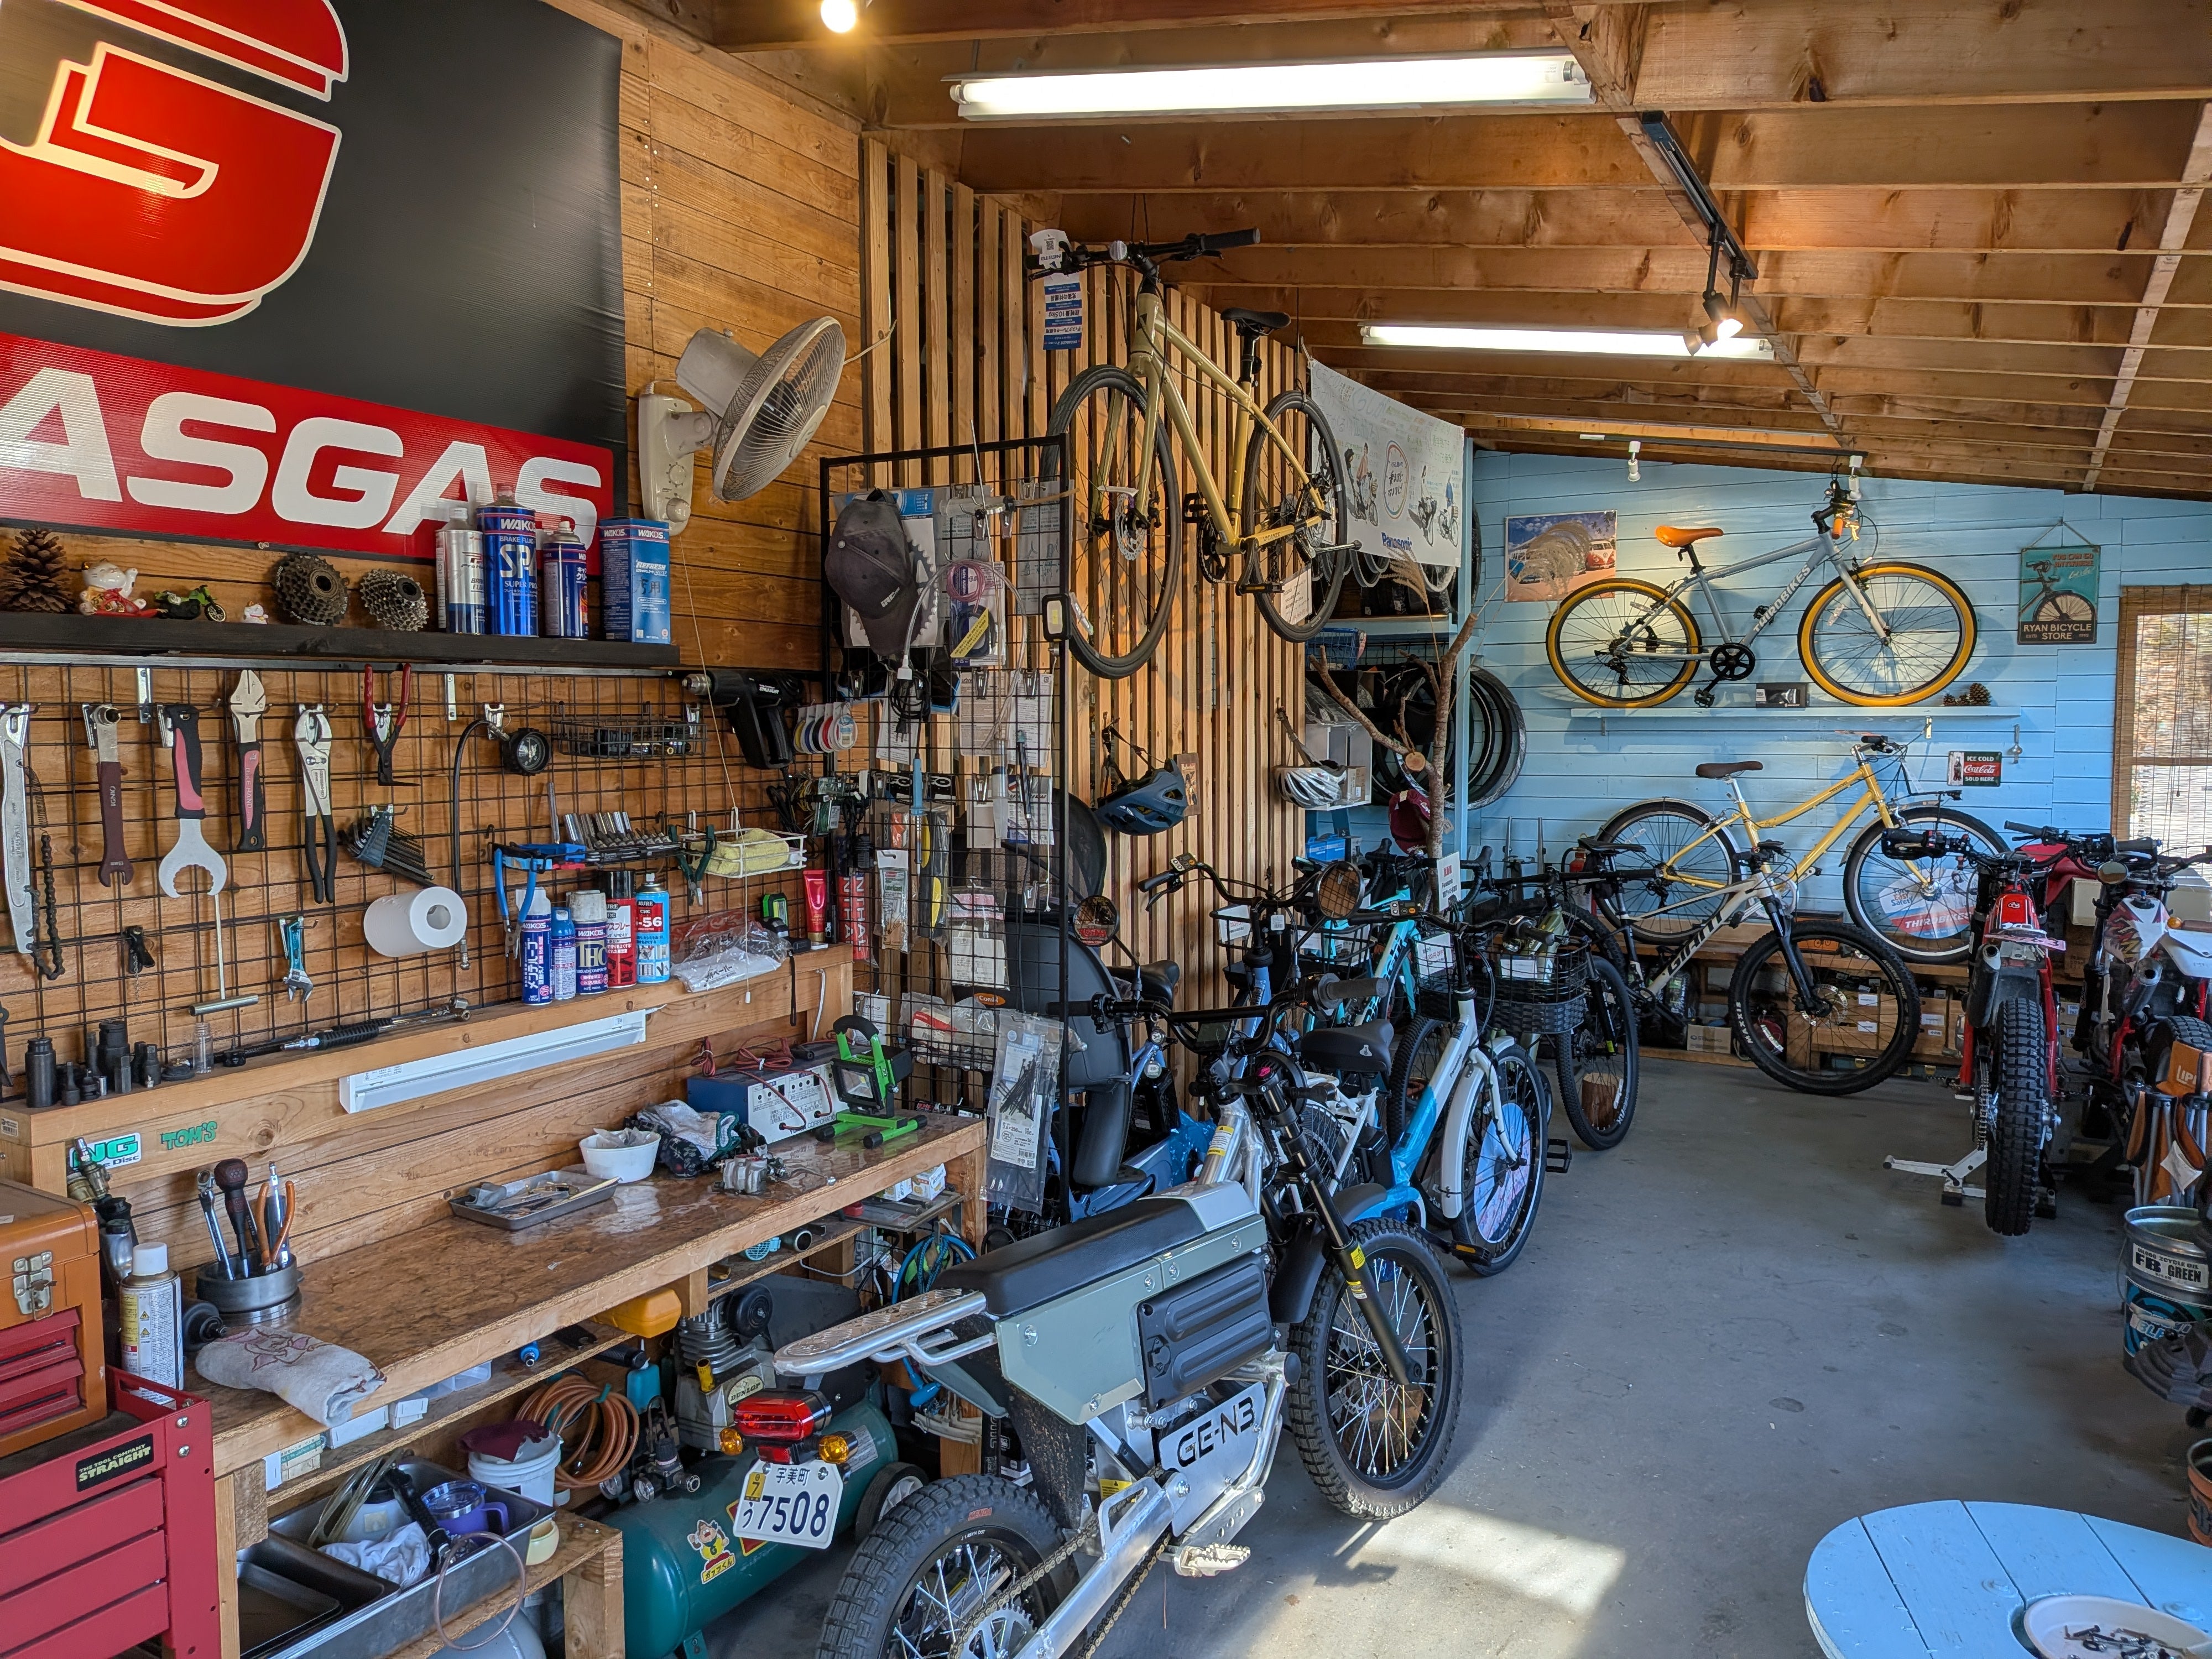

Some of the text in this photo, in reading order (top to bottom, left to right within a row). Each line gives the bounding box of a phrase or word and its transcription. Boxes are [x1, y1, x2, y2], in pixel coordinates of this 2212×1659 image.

[1381, 532, 1412, 551] Panasonic
[1753, 564, 1811, 632] THIRDBIKES
[2023, 623, 2092, 633] RYAN BICYCLE
[2042, 632, 2073, 640] STORE
[1891, 897, 1913, 906] Safety
[1905, 912, 1969, 929] THIRDBIKES
[1668, 911, 1722, 975] GIANT
[1735, 1001, 1753, 1044] MAXXIS
[1449, 1053, 1463, 1077] Panasonic
[807, 1113, 837, 1129] CORPORATIO
[161, 1120, 217, 1150] TOM'S
[113, 1155, 139, 1165] Disc
[2136, 1252, 2201, 1283] FB GREEN
[731, 1383, 761, 1401] DUNLOP
[1177, 1396, 1255, 1468] GE-N3
[79, 1443, 146, 1473] THE TOOL COMPANY
[79, 1446, 151, 1482] STRAIGHT
[776, 1467, 811, 1486] 宇美町
[751, 1482, 760, 1496] 7
[743, 1491, 830, 1537] う 7508
[968, 1507, 993, 1521] KENDA
